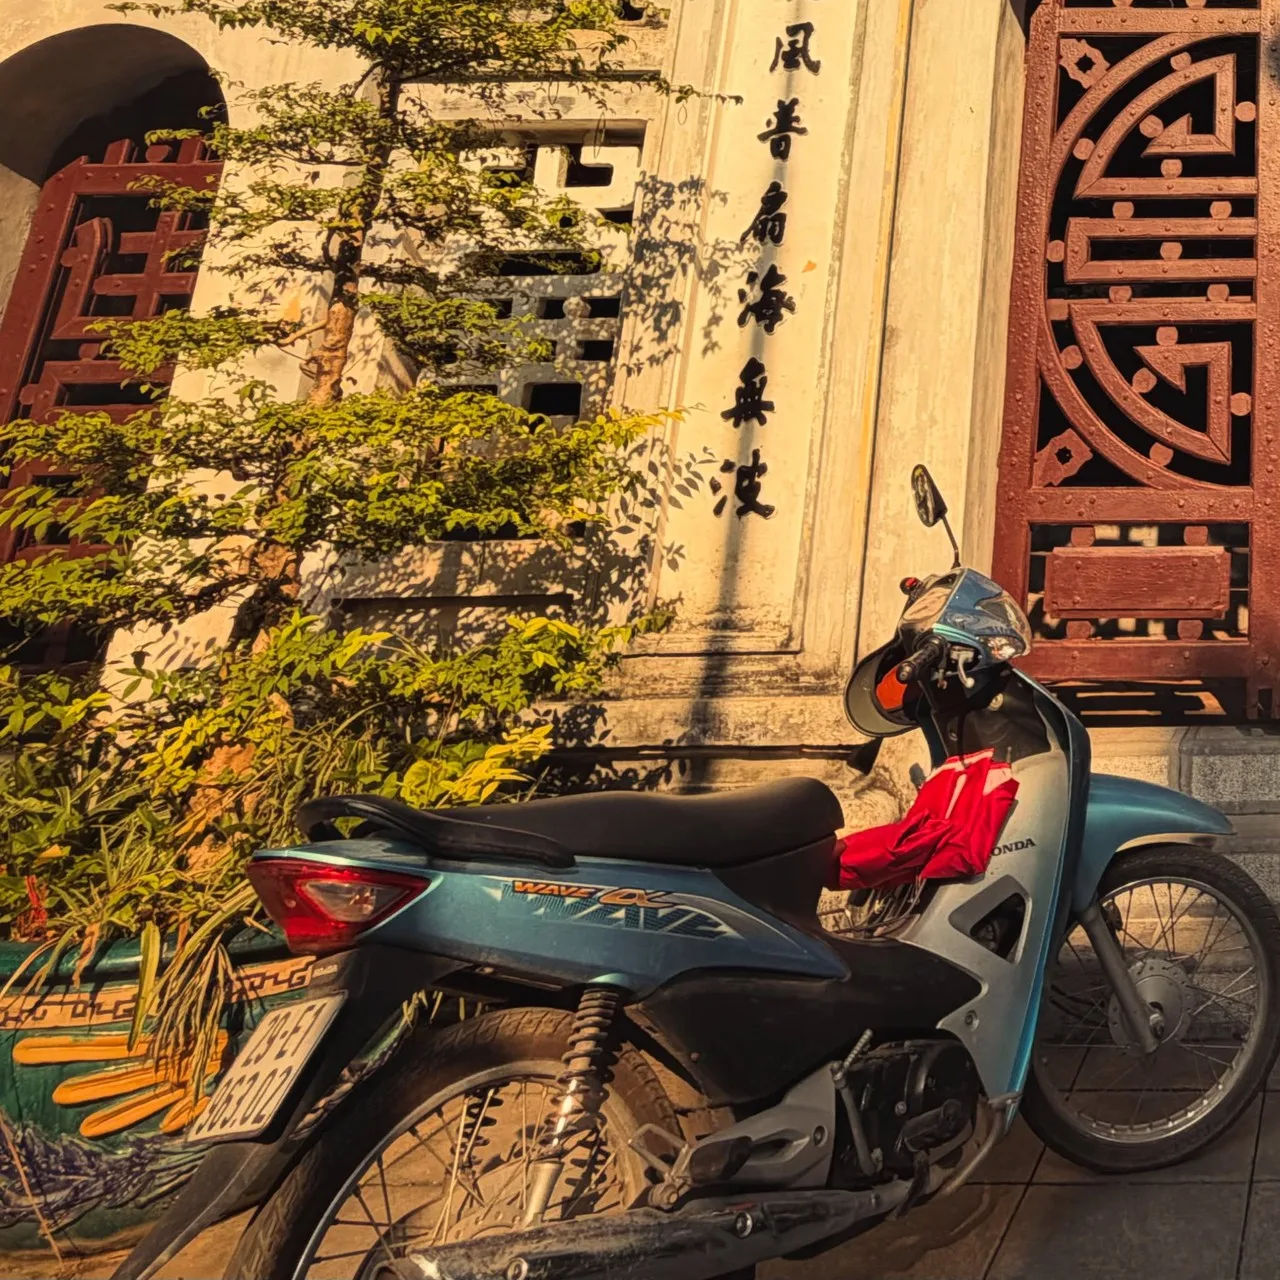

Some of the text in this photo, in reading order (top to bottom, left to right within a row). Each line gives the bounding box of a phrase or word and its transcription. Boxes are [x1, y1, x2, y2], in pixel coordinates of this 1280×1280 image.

[990, 837, 1036, 857] ONDA
[513, 879, 597, 899] WAVE
[241, 1002, 327, 1067] 29-E1
[195, 1065, 294, 1135] 963.02
